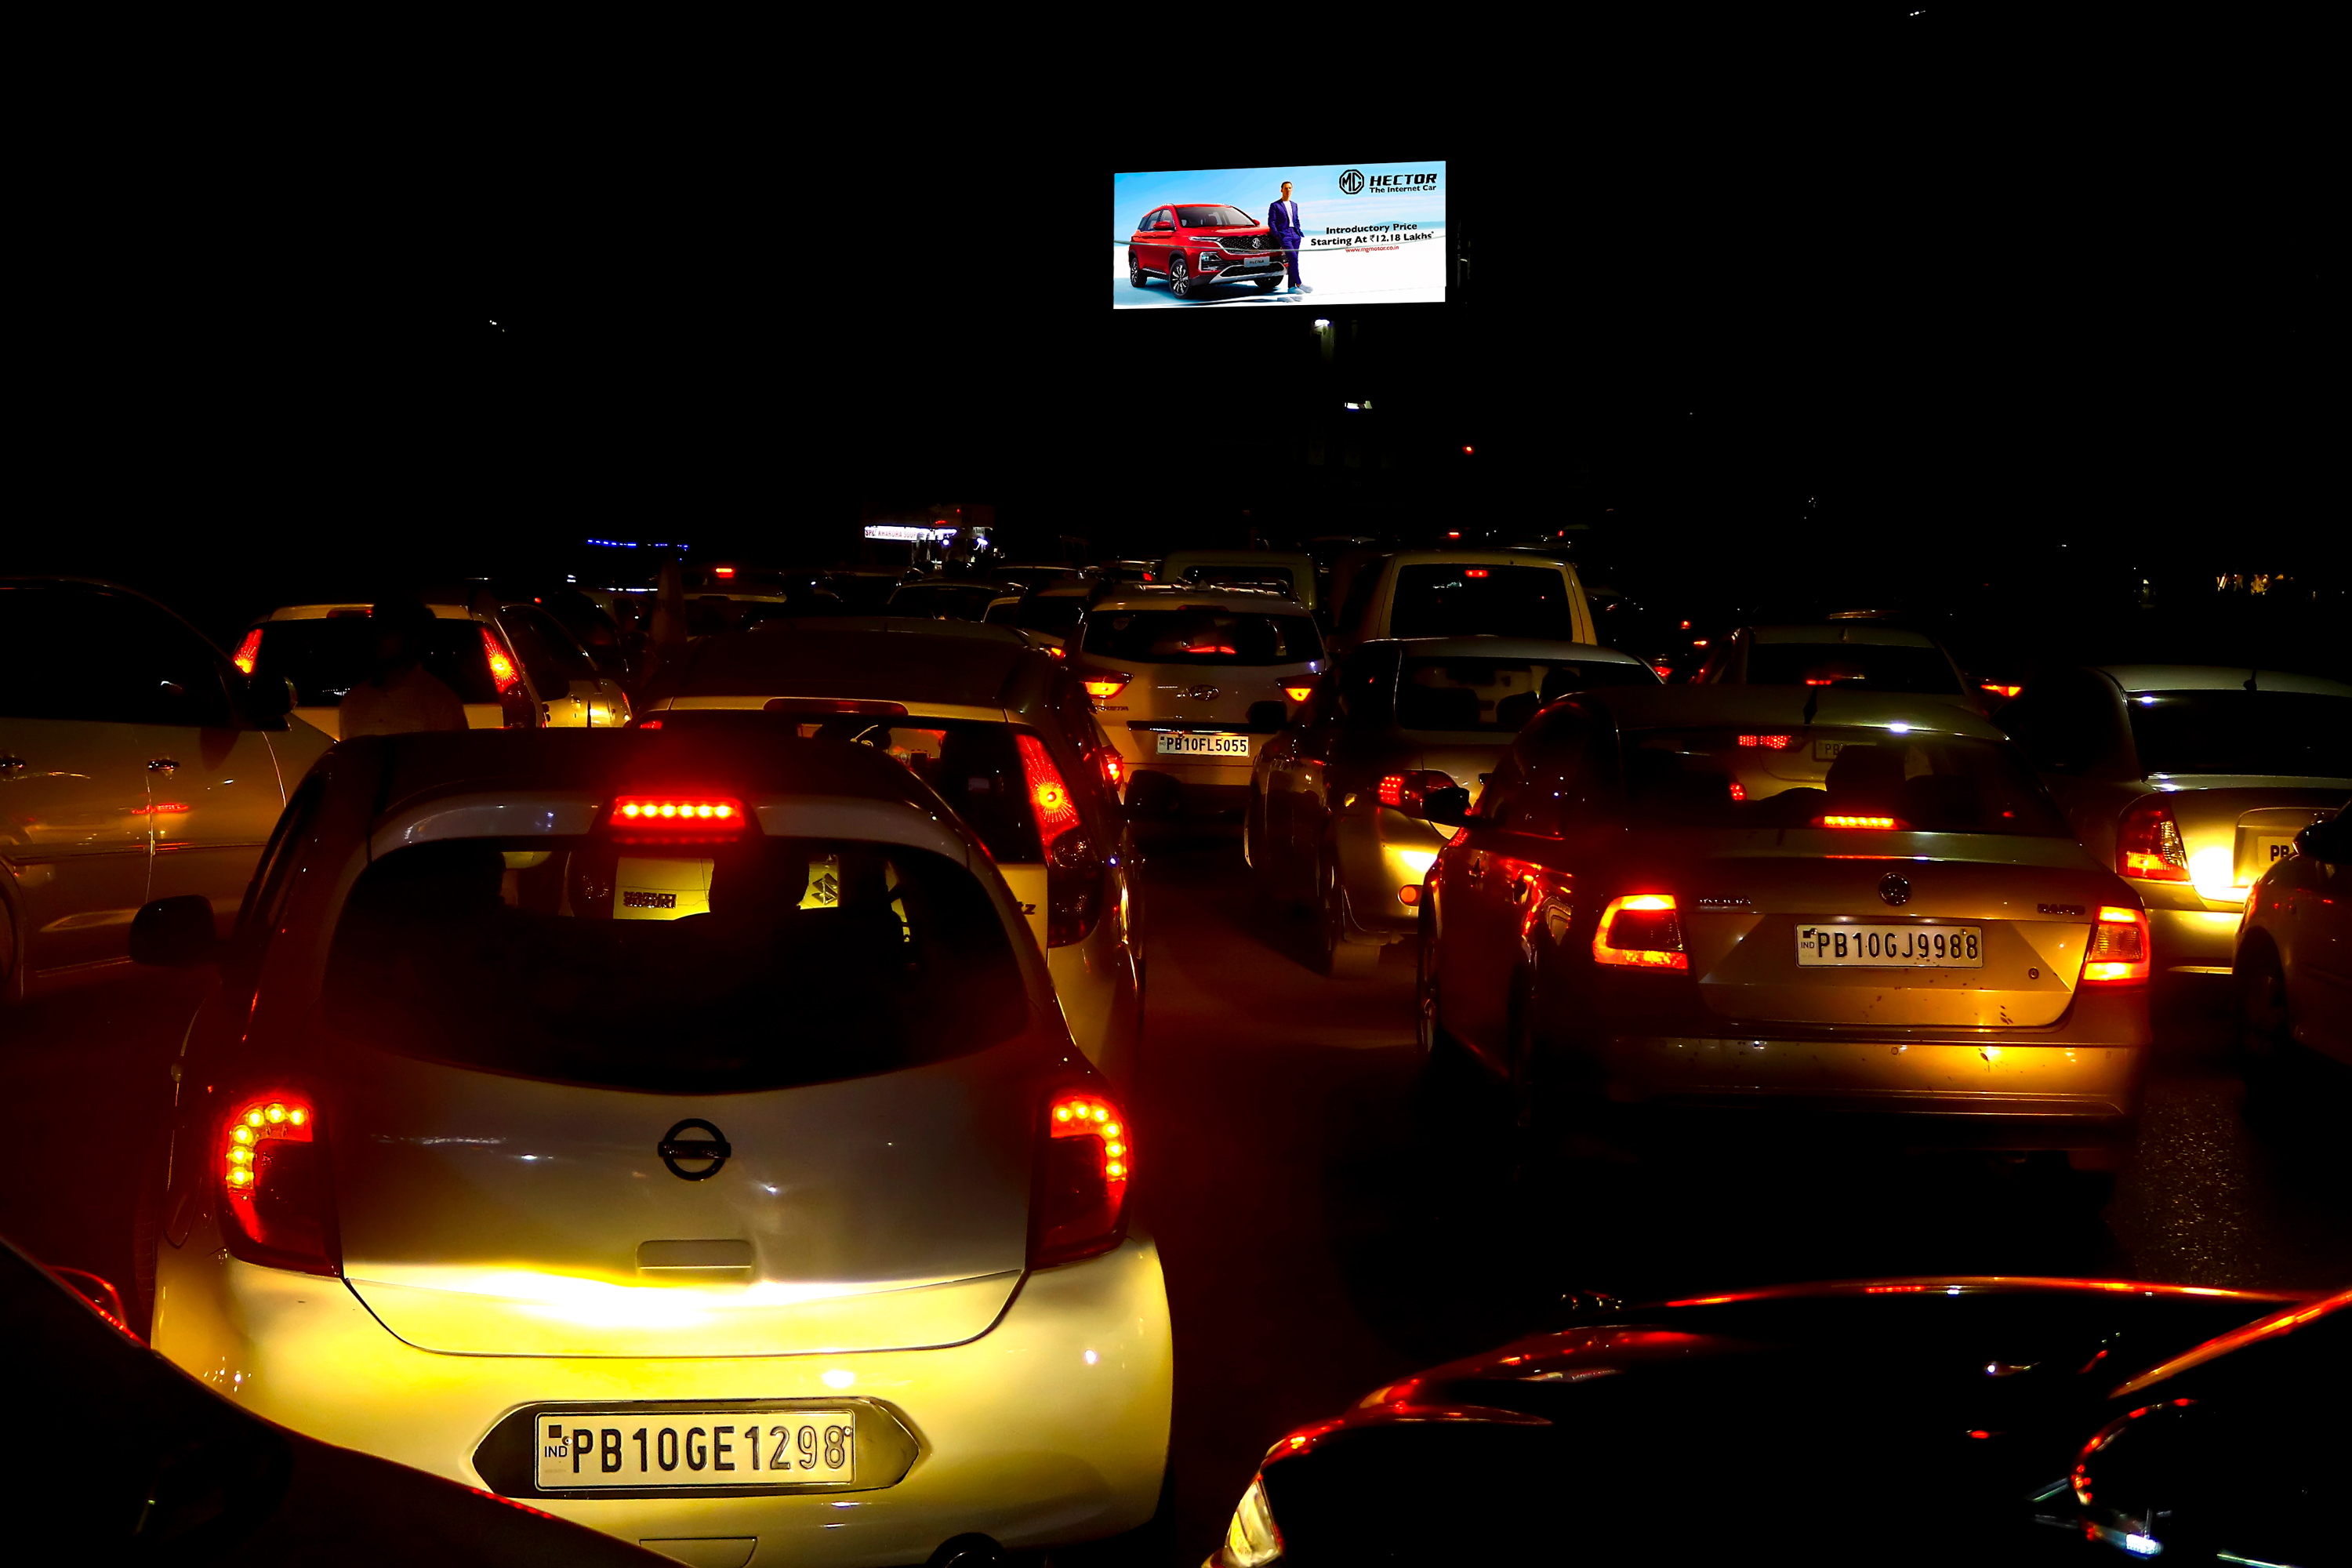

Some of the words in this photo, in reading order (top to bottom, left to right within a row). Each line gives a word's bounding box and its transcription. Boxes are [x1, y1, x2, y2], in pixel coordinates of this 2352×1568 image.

[1341, 171, 1363, 193] MG
[1370, 173, 1437, 187] HECTOR
[1326, 224, 1390, 234] Introductory
[1310, 237, 1352, 246] Starting
[1354, 235, 1367, 244] At
[1345, 245, 1399, 253] www.mgmotor.co.in
[1167, 737, 1247, 752] PB10FL5055
[1817, 932, 1978, 960] PB10GJ9988
[544, 1446, 568, 1458] IND
[572, 1425, 846, 1473] PB10GE1298
